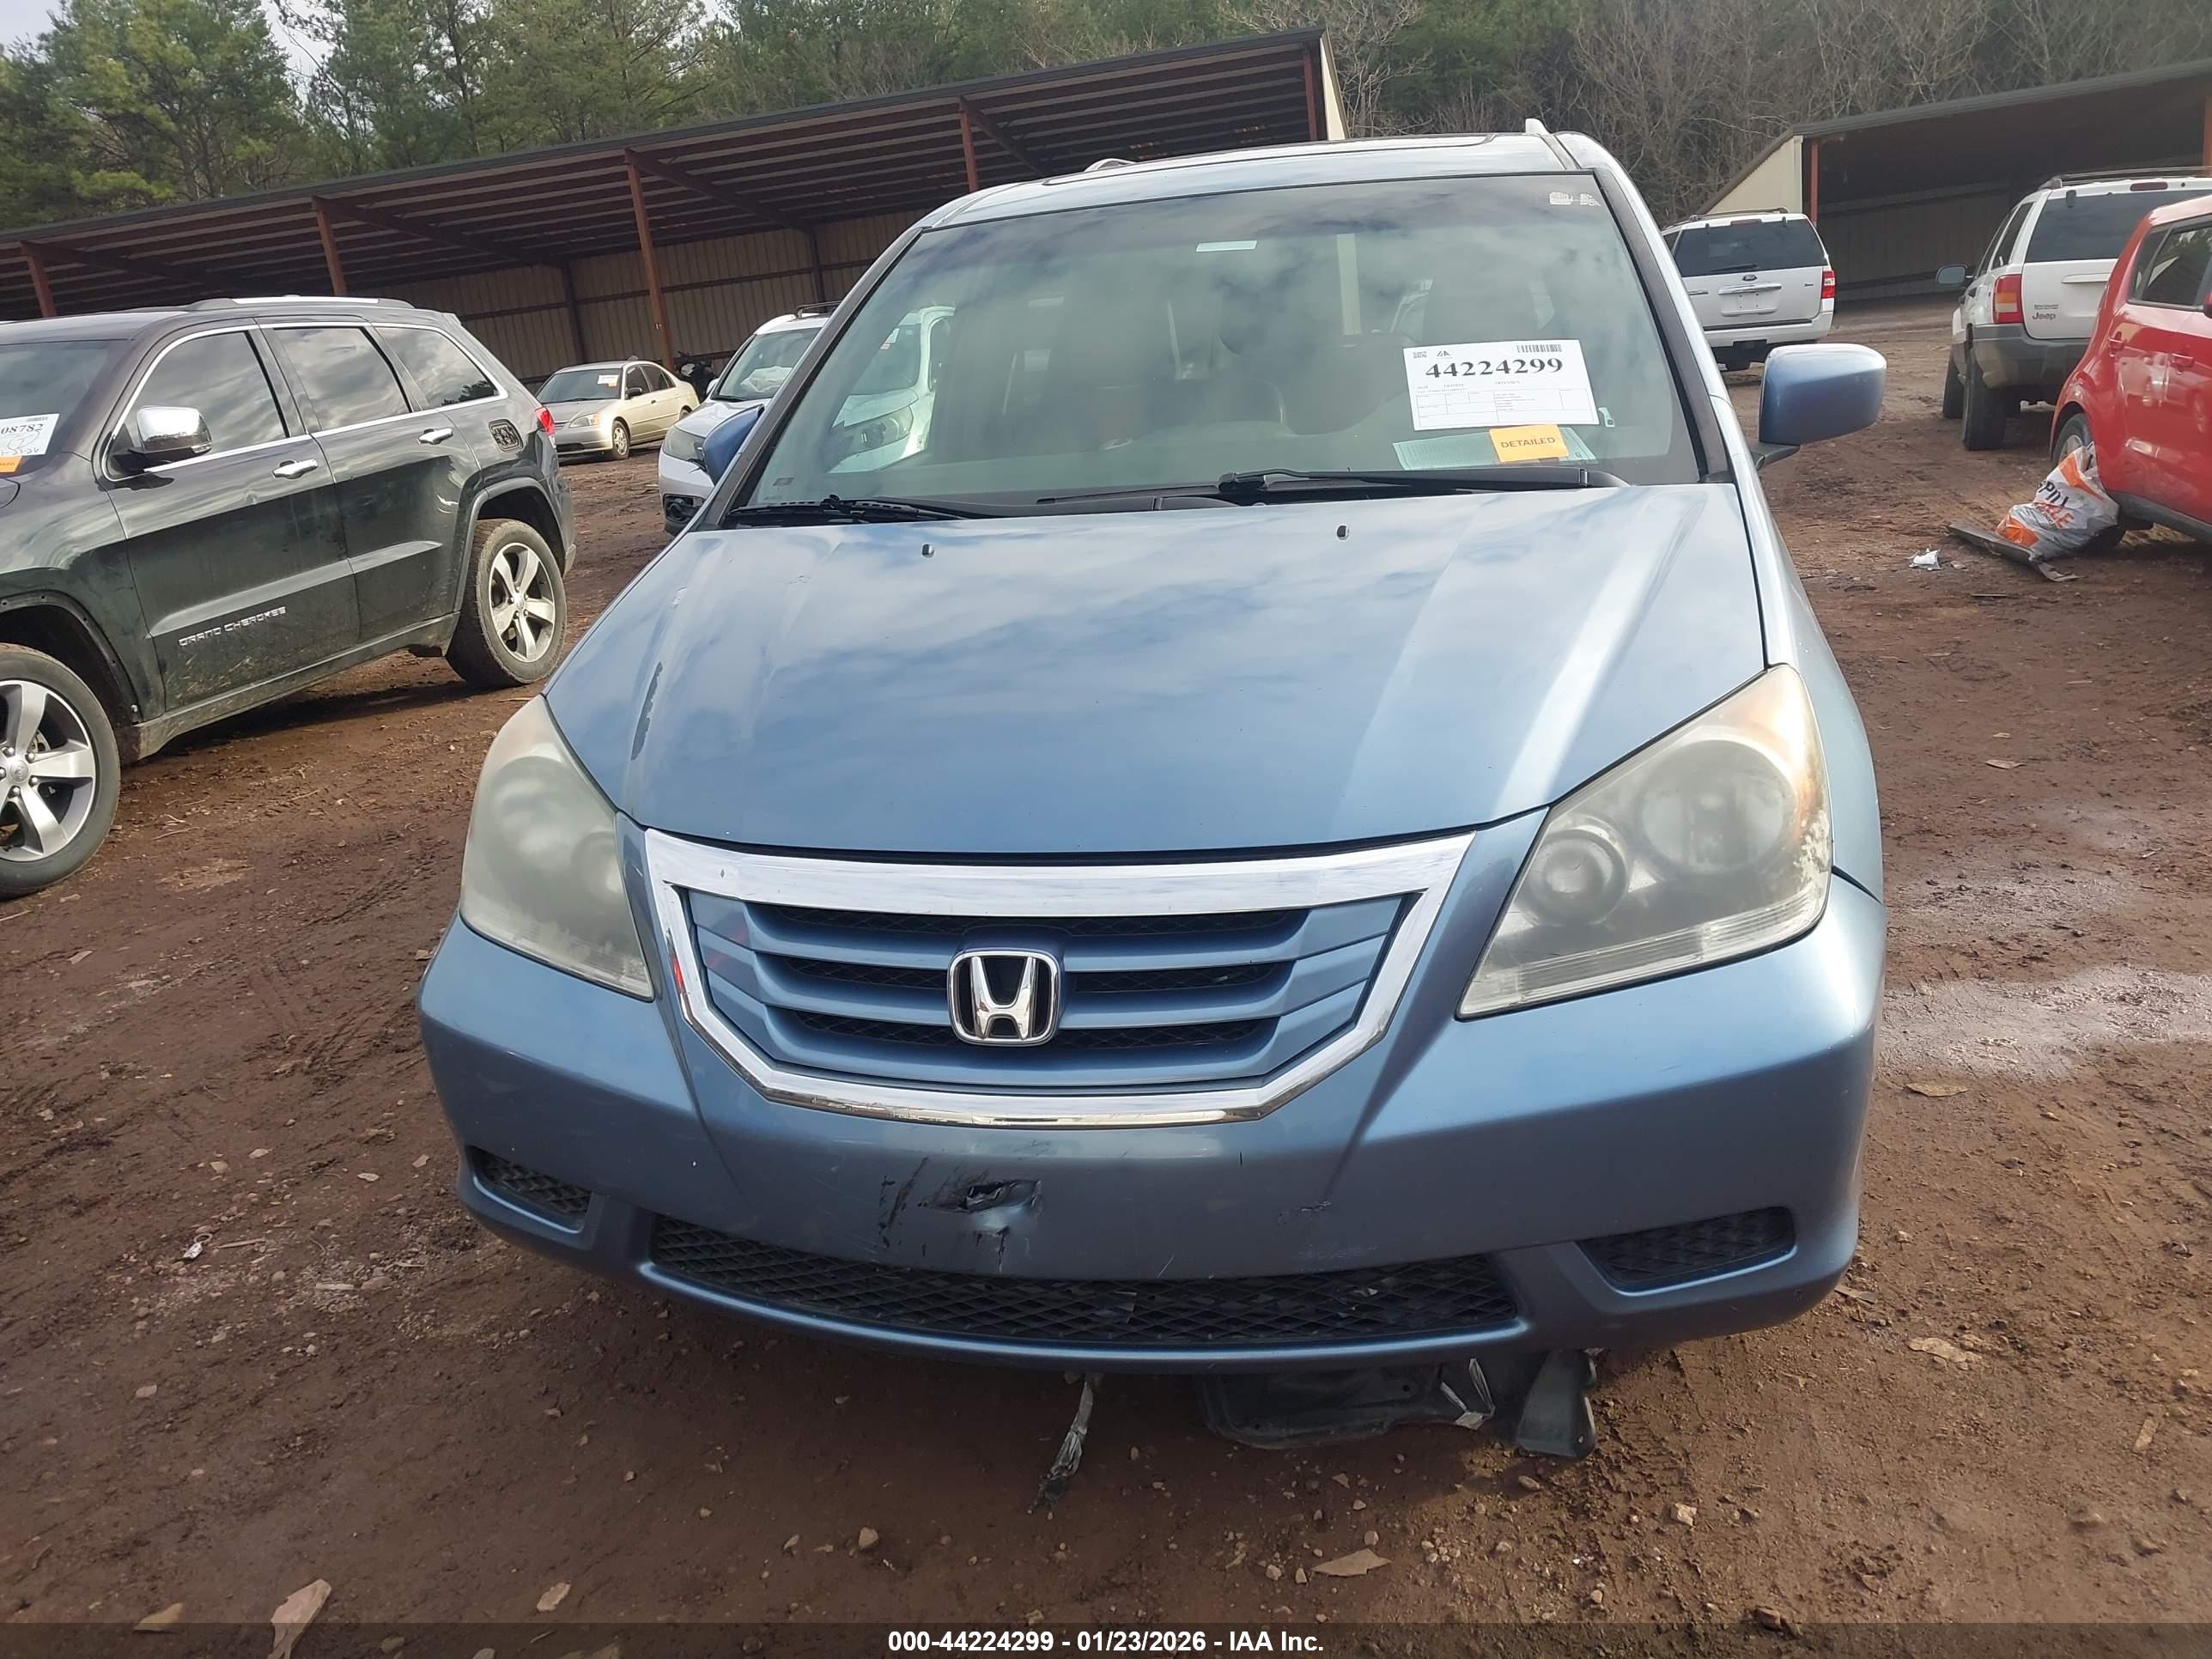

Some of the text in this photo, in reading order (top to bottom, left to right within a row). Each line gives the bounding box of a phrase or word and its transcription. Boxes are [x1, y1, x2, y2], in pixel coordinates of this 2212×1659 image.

[2032, 312, 2057, 320] Jeep
[1425, 357, 1564, 378] 44224299
[1500, 436, 1556, 448] DETAILED
[178, 606, 286, 647] GRAND CHEROKEE
